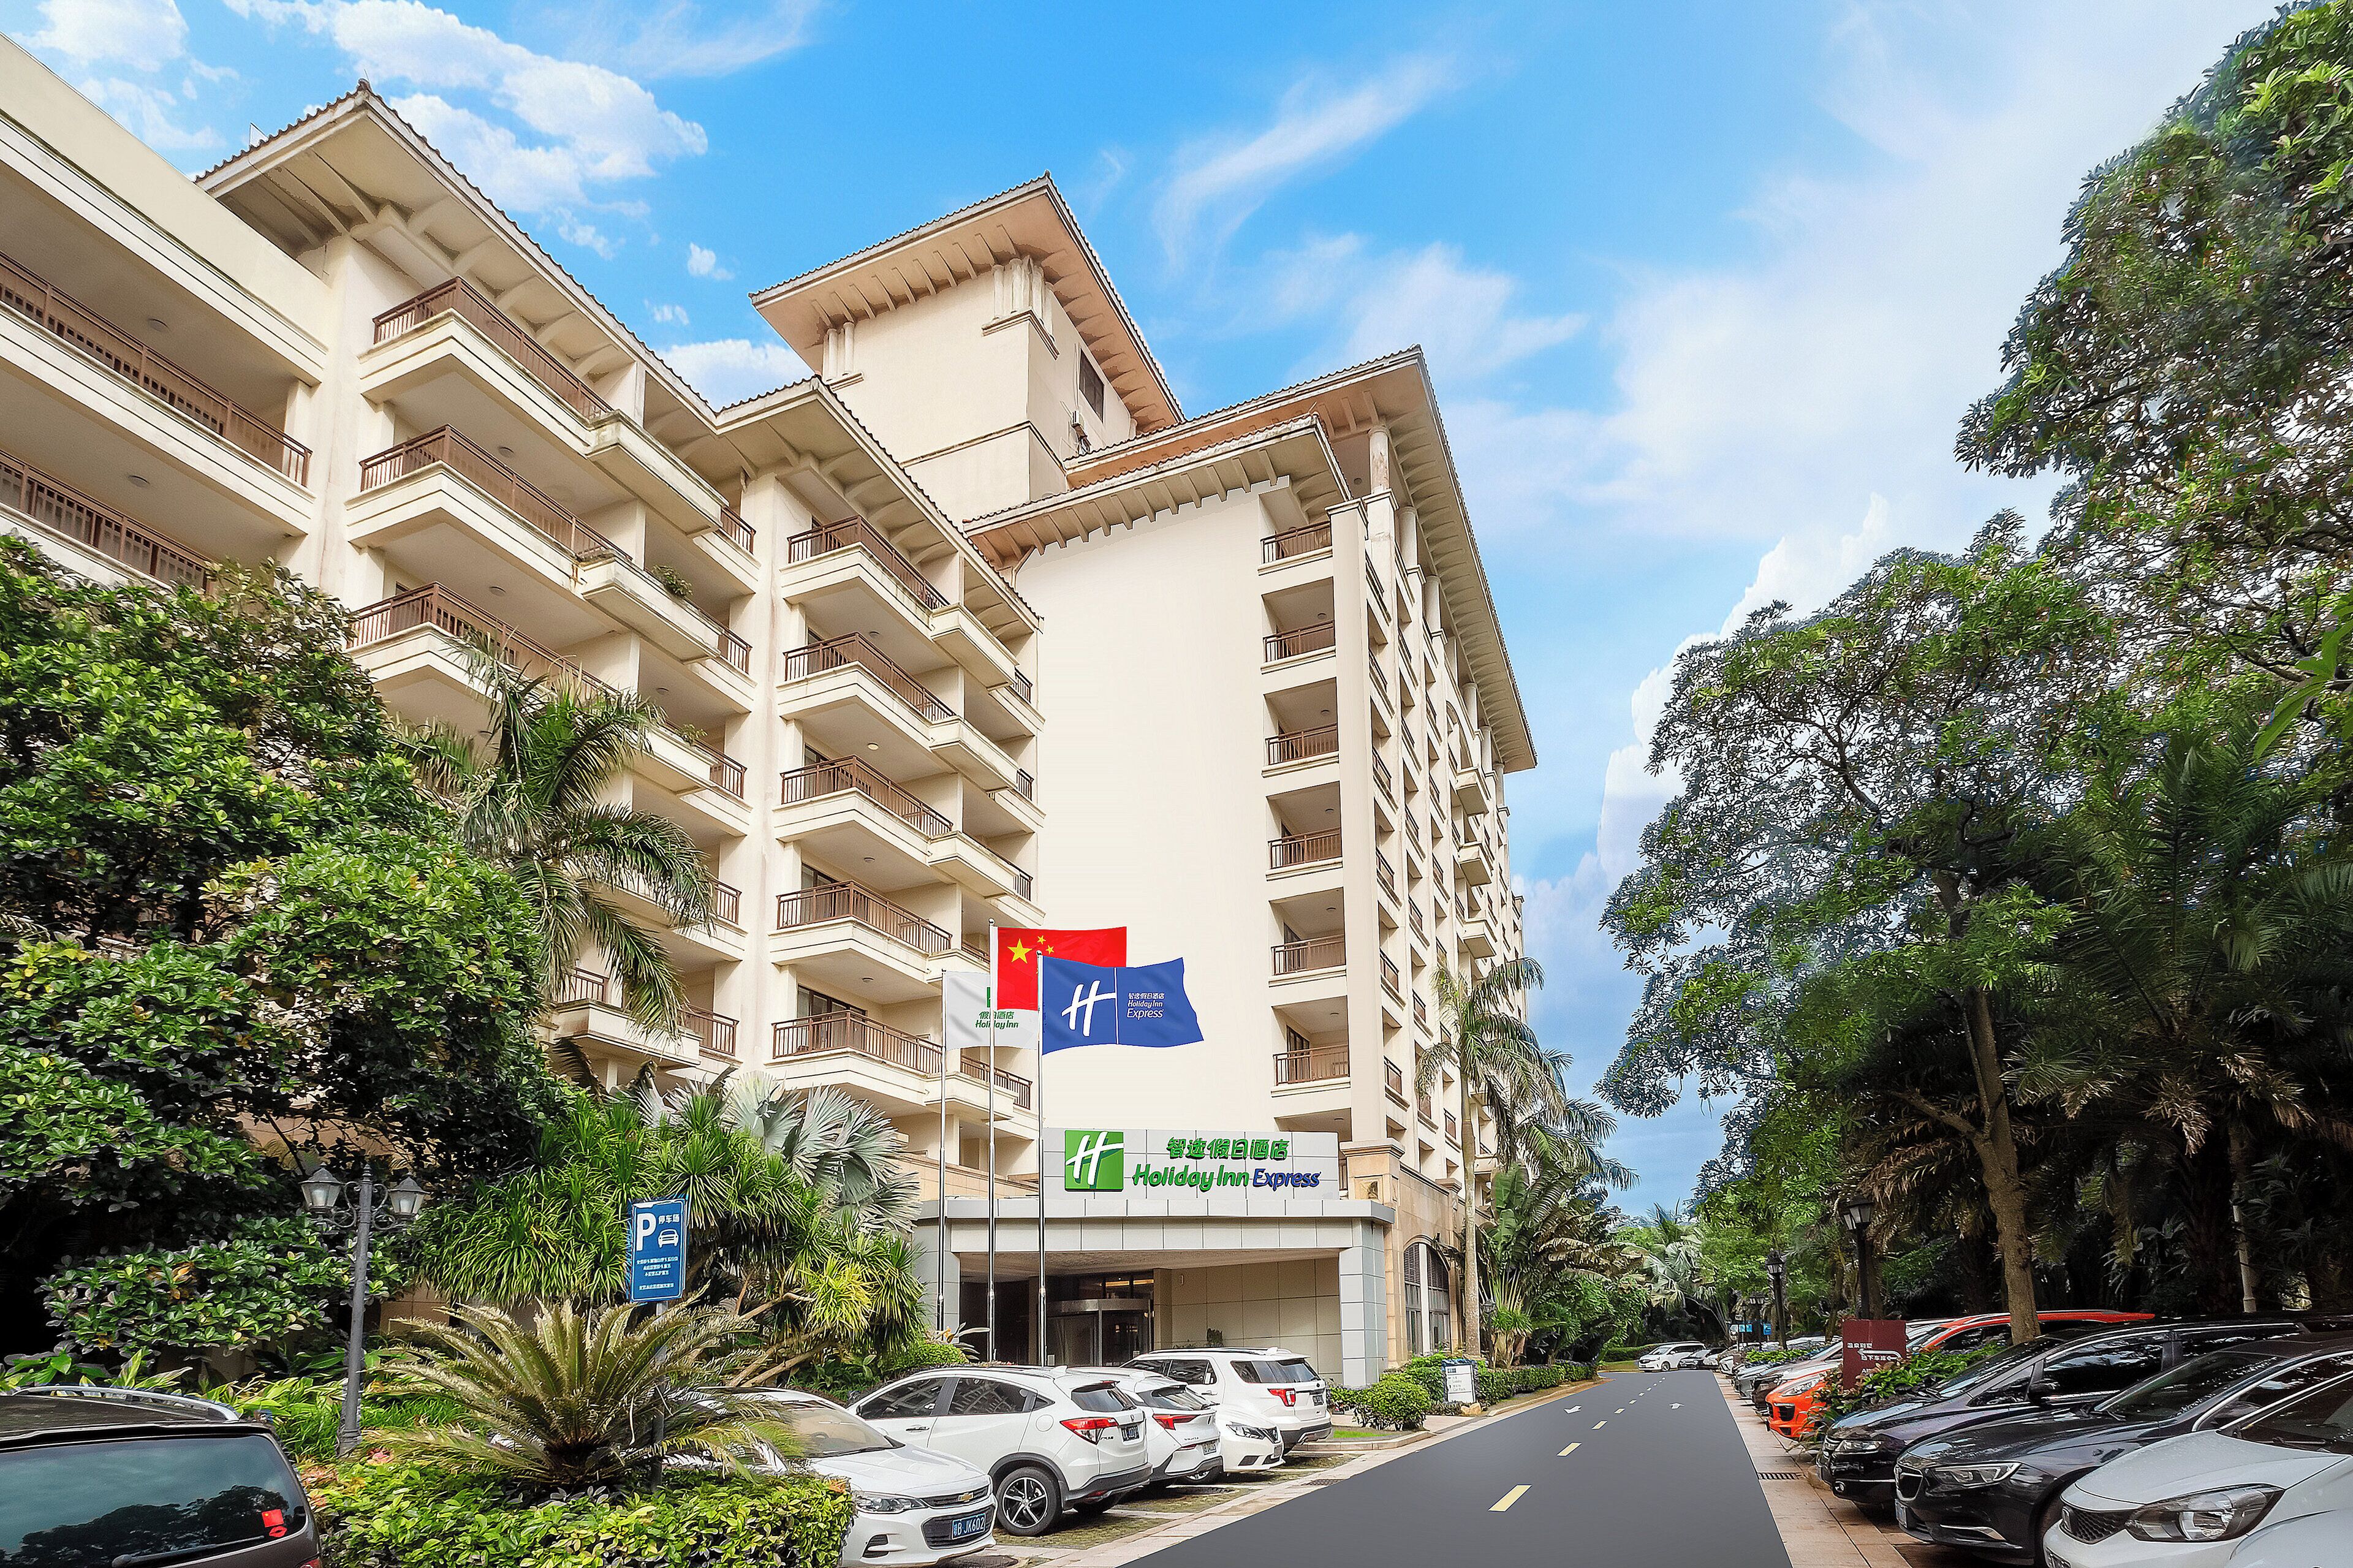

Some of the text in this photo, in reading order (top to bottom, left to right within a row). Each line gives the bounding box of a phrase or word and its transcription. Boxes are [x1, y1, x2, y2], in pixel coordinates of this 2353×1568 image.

[1127, 999, 1153, 1009] Holiday
[1127, 1008, 1164, 1020] Express
[1006, 1020, 1018, 1028] Inn
[1166, 1137, 1290, 1160] 智选假日酒店
[1132, 1164, 1321, 1192] Holiday Inn Express
[637, 1213, 657, 1251] P
